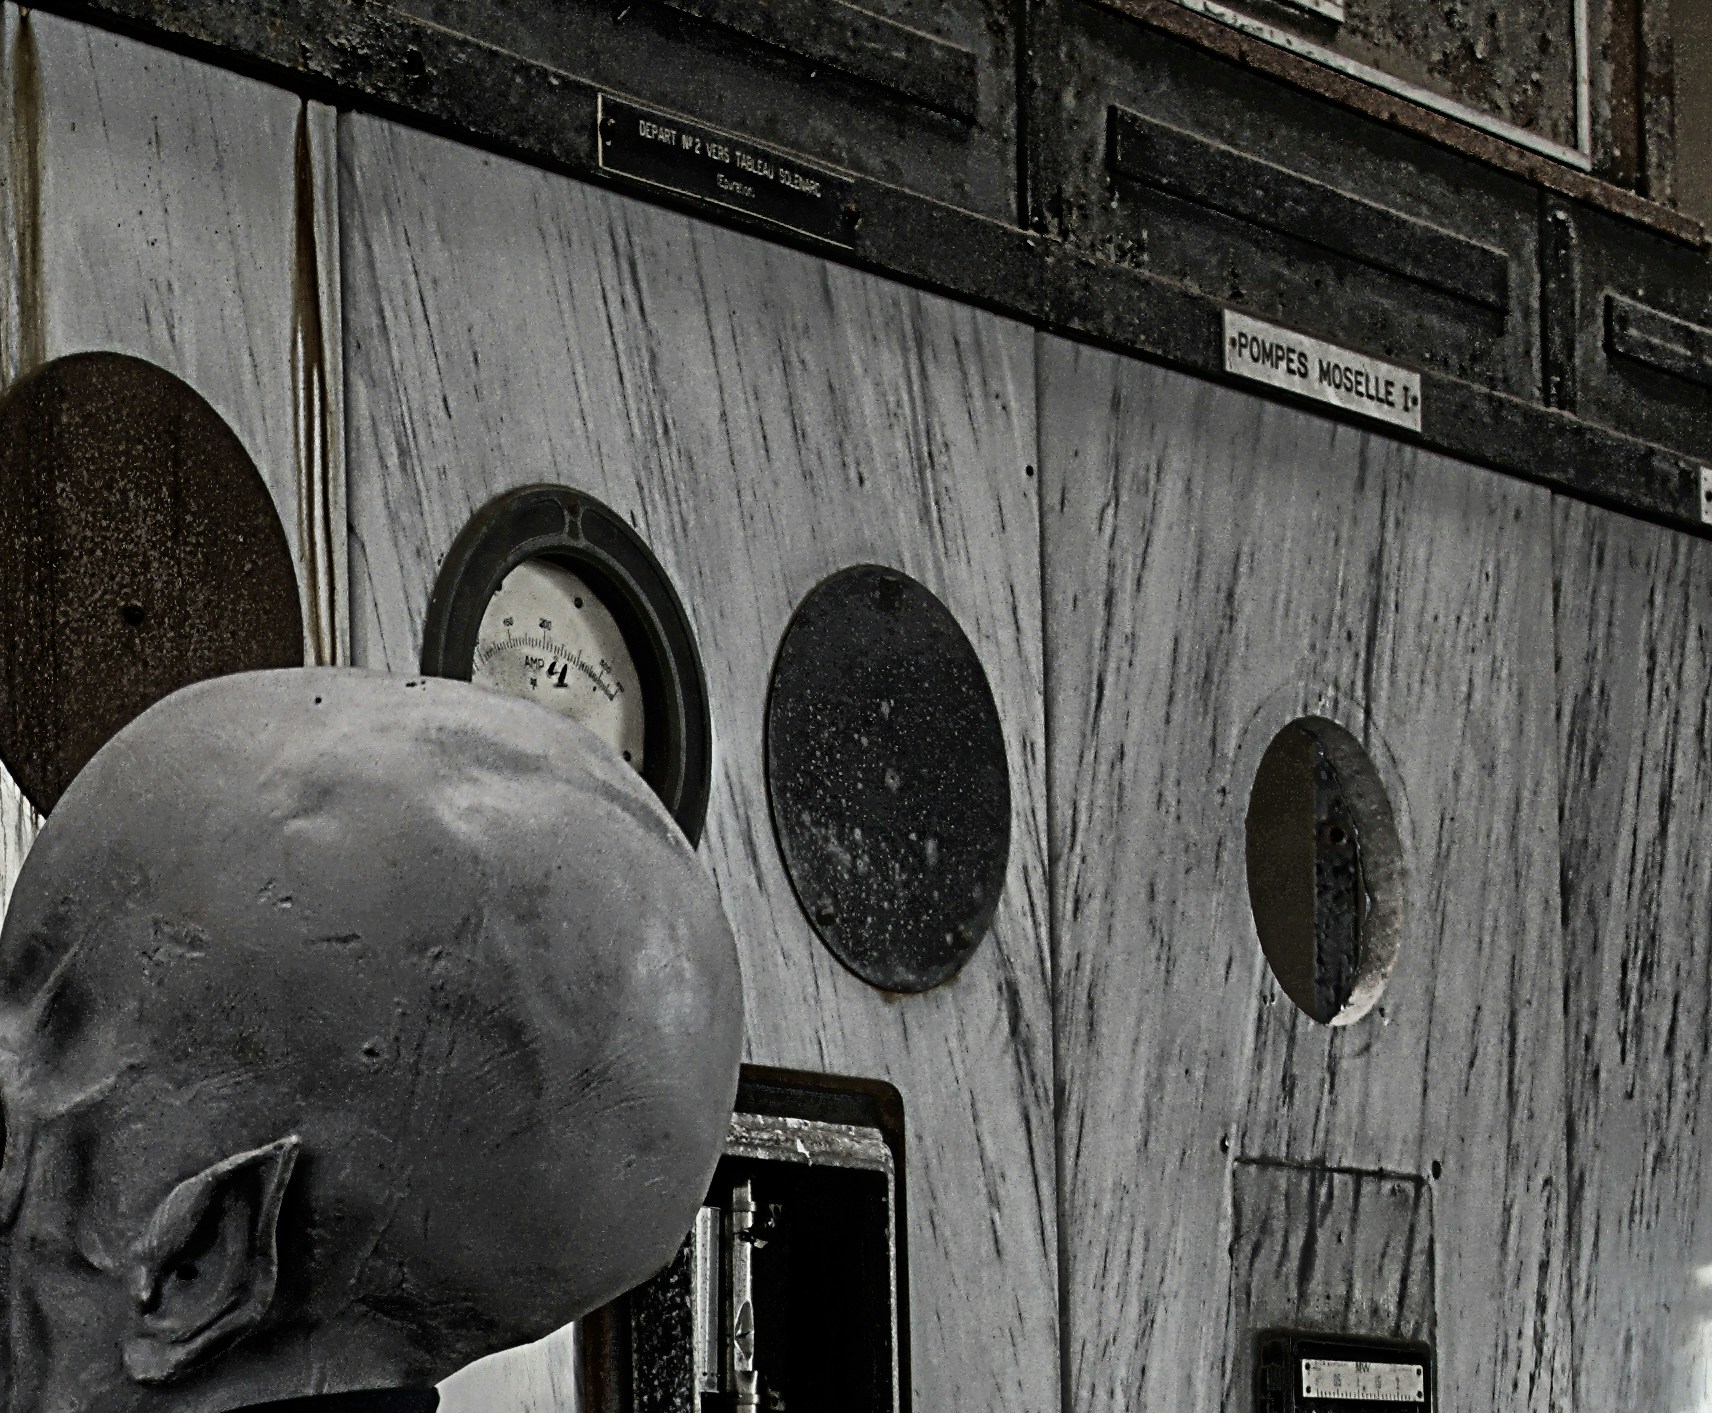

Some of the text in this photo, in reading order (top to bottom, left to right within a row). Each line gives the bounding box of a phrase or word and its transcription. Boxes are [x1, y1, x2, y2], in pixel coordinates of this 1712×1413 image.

[639, 119, 677, 147] DEPART
[706, 142, 730, 164] VERS
[735, 151, 774, 180] TABLEAU
[1237, 331, 1309, 379] POMPES
[1318, 358, 1395, 408] MOSELLE
